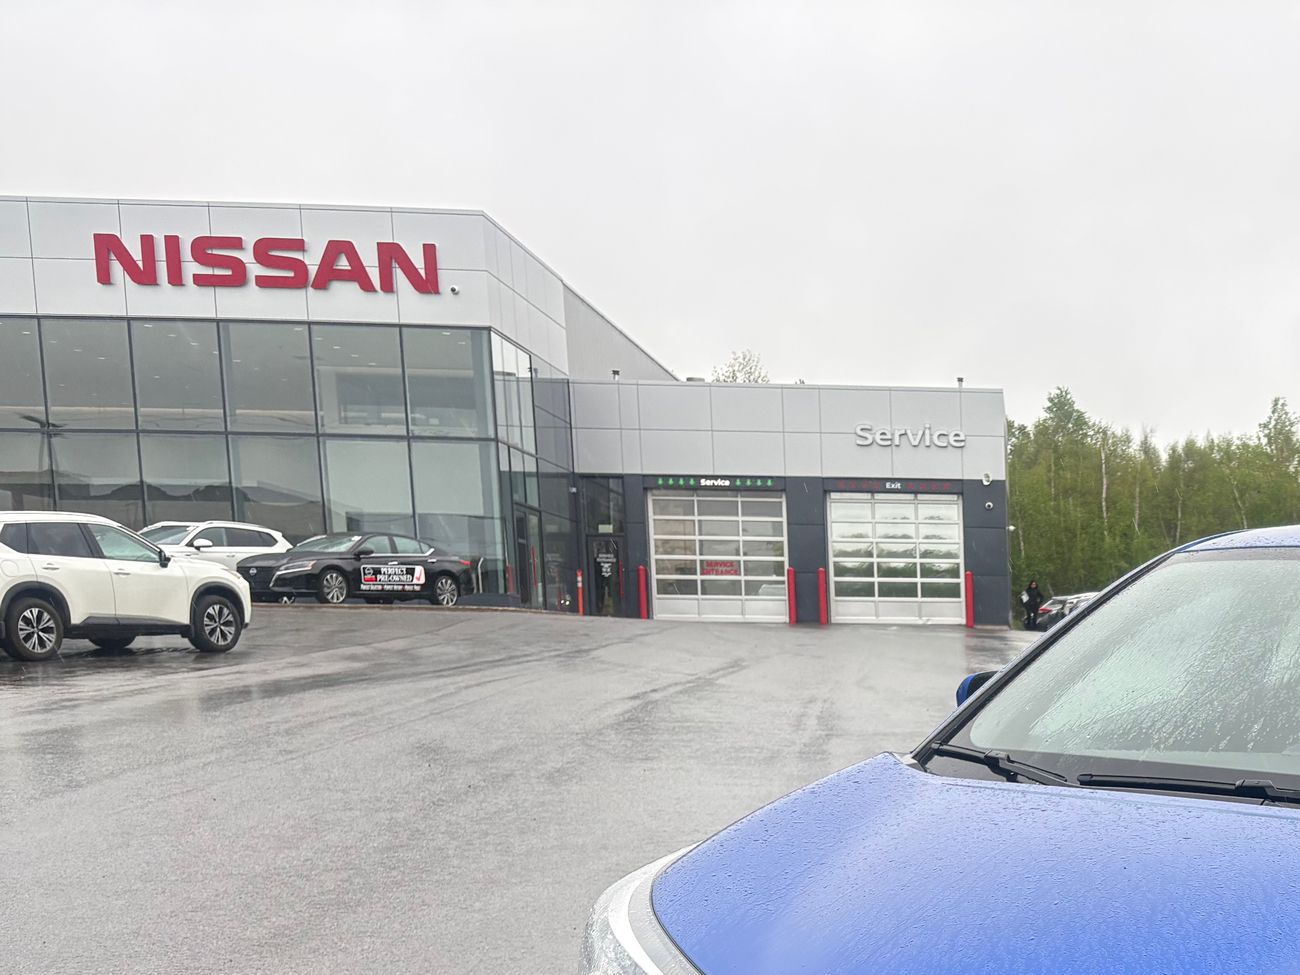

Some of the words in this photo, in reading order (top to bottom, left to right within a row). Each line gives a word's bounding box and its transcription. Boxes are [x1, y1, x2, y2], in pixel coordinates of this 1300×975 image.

[93, 233, 441, 295] NISSAN
[855, 423, 966, 448] Service
[700, 478, 730, 486] Service
[381, 567, 406, 575] PERFECT
[377, 574, 412, 582] PRE-OWNED
